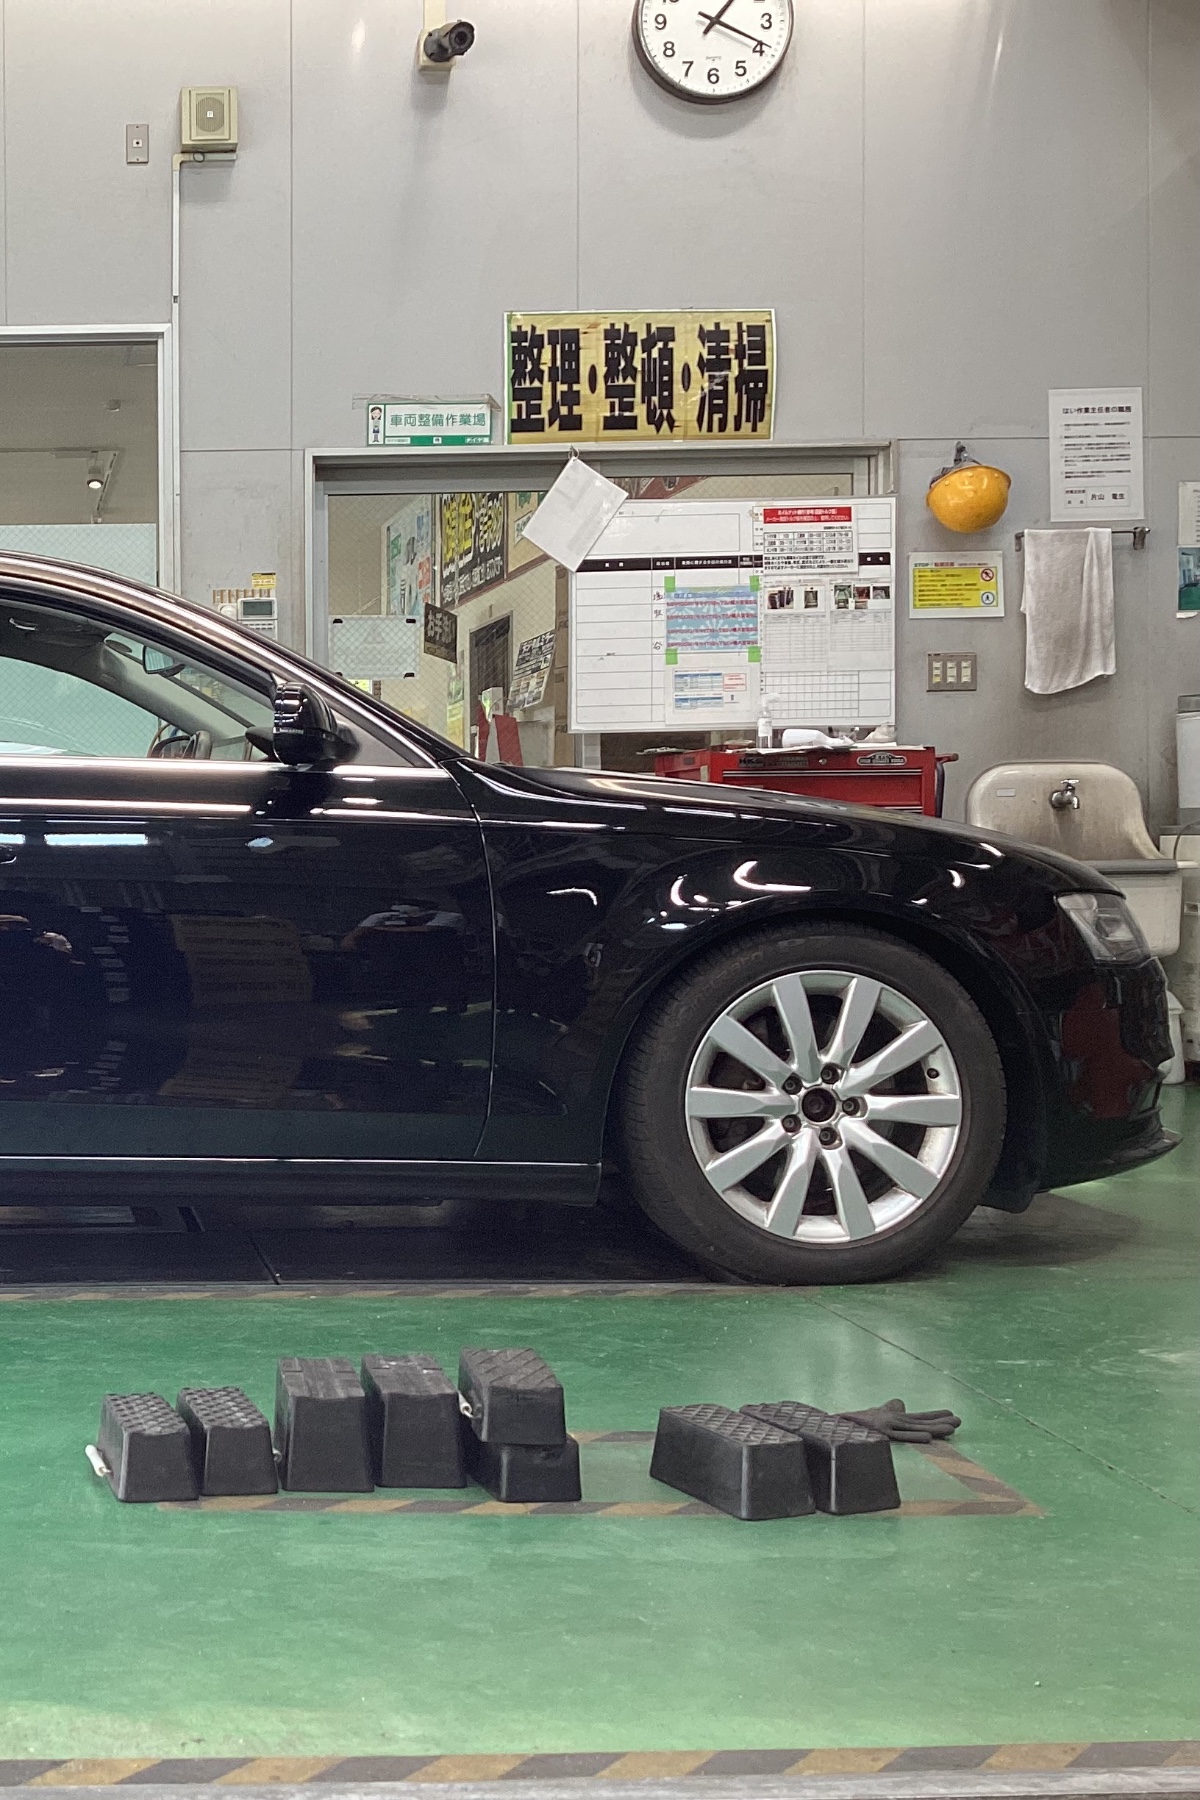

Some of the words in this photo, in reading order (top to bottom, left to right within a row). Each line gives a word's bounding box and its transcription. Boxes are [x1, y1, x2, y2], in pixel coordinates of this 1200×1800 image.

[654, 13, 667, 31] 9
[760, 12, 773, 30] 3
[662, 41, 676, 58] 8
[752, 40, 765, 57] 4
[681, 60, 694, 78] 7
[707, 67, 720, 84] 6
[734, 60, 747, 77] 5
[510, 322, 769, 434] 整理・整頓・清掃
[389, 412, 486, 427] 車両整備作業場
